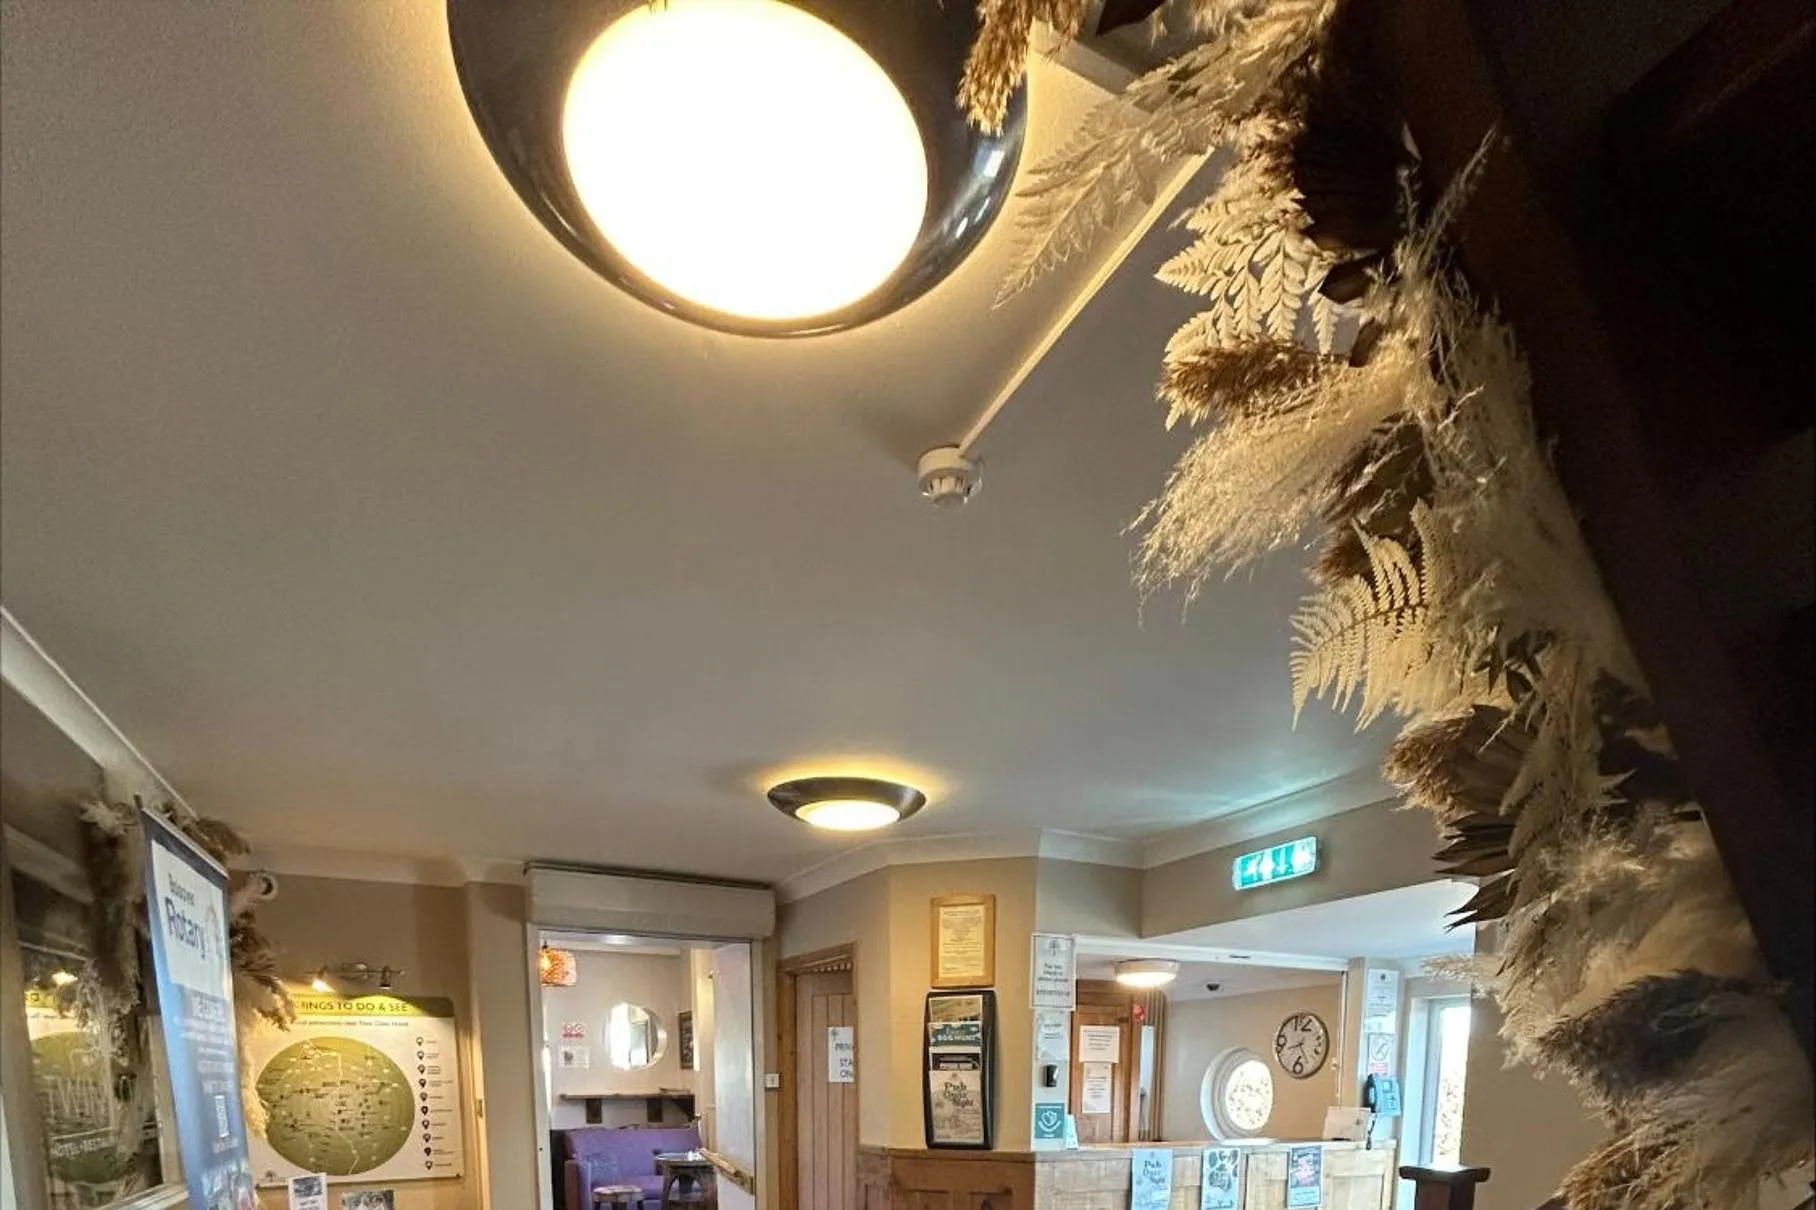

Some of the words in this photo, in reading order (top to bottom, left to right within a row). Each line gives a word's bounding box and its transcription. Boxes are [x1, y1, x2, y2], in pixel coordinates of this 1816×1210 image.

[164, 895, 206, 960] Rotary
[301, 1000, 335, 1011] HINGS
[338, 1001, 353, 1011] TO
[356, 1001, 376, 1012] DO
[1294, 1015, 1312, 1032] 12
[1292, 1055, 1304, 1075] 6
[944, 1081, 967, 1091] Pub
